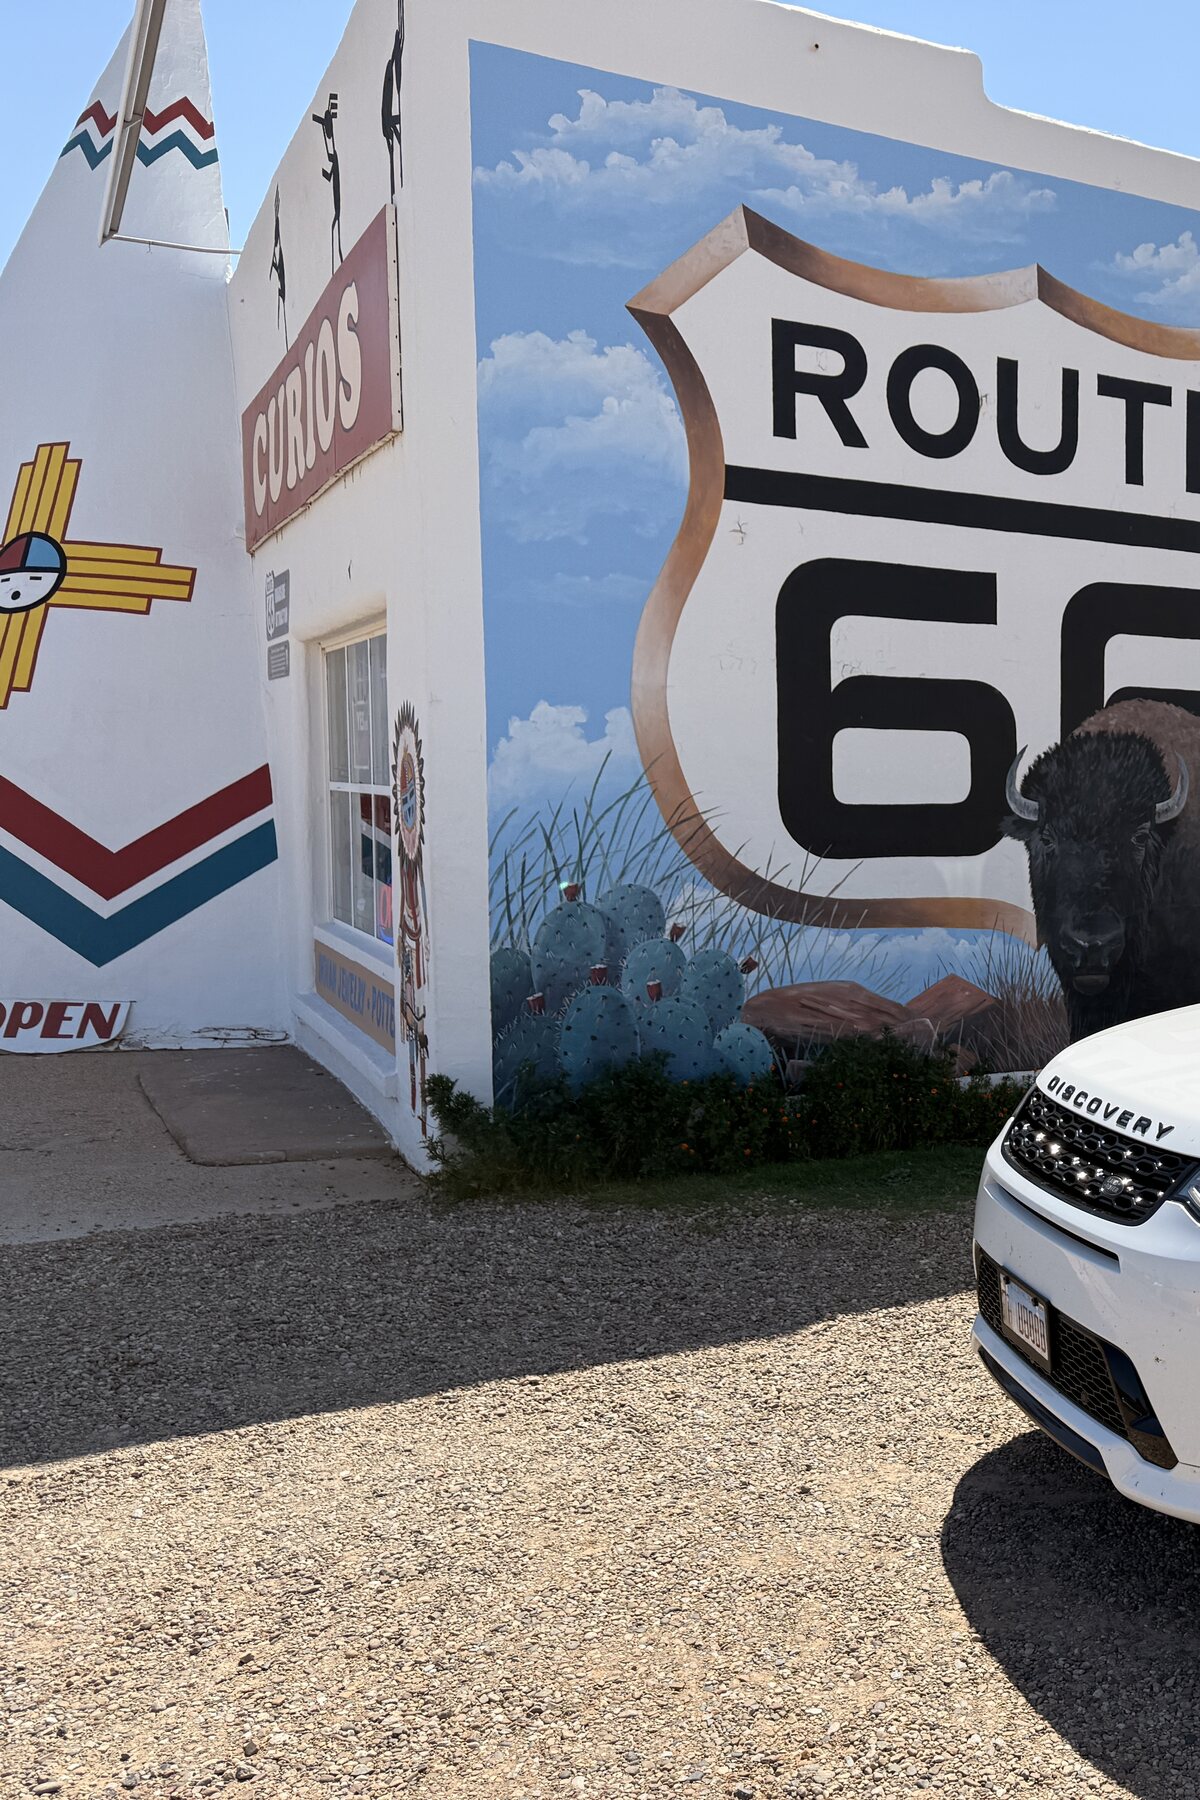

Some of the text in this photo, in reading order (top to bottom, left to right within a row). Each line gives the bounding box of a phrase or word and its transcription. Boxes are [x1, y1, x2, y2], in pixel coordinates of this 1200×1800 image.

[252, 281, 362, 517] CURIOS
[0, 1001, 121, 1039] PEN
[1047, 1075, 1175, 1141] DISCOVERY
